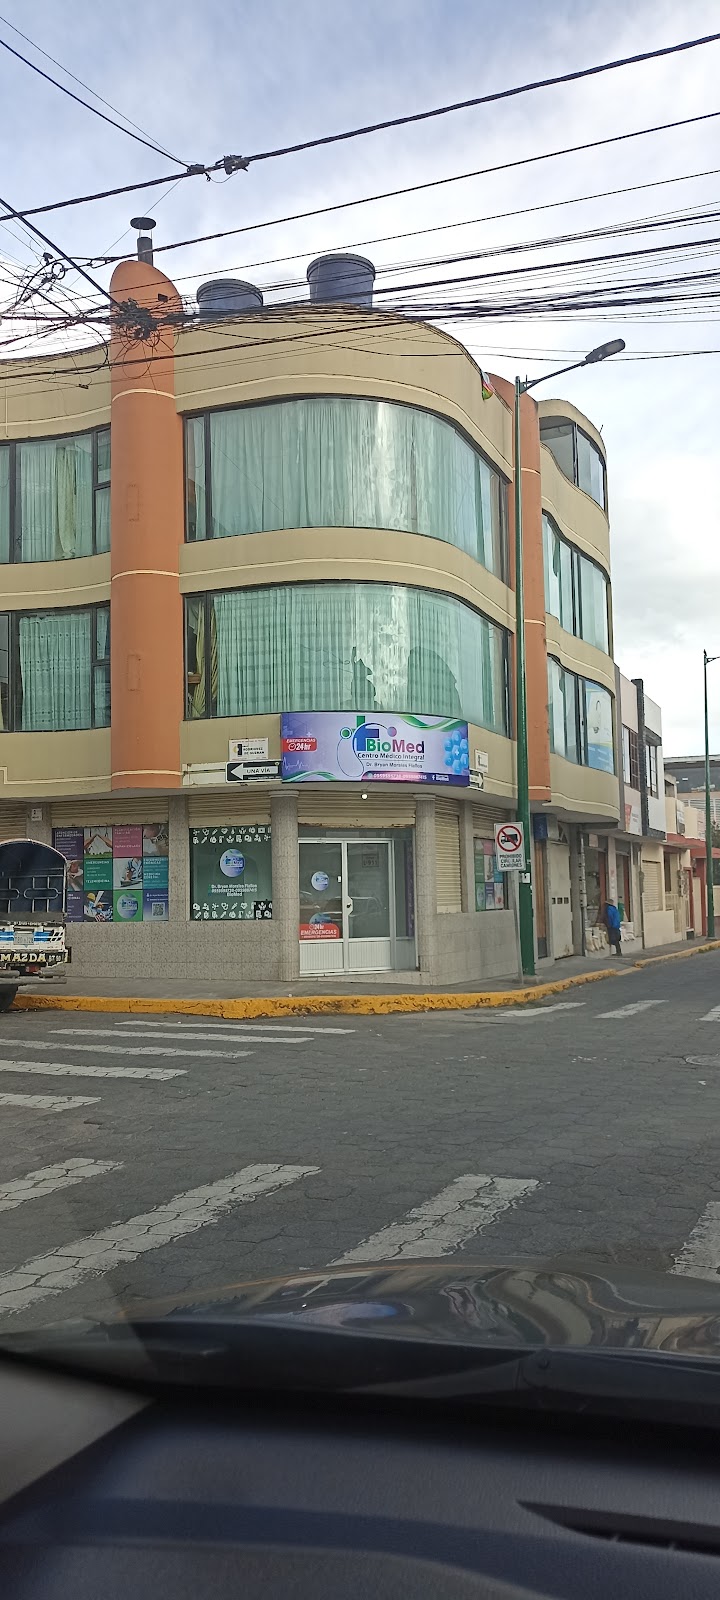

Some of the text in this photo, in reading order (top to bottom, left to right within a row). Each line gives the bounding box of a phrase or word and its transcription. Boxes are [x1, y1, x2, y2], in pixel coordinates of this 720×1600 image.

[366, 738, 425, 754] BioMed
[380, 751, 402, 759] Médico
[403, 753, 425, 761] Integral
[0, 953, 47, 962] MAZDA
